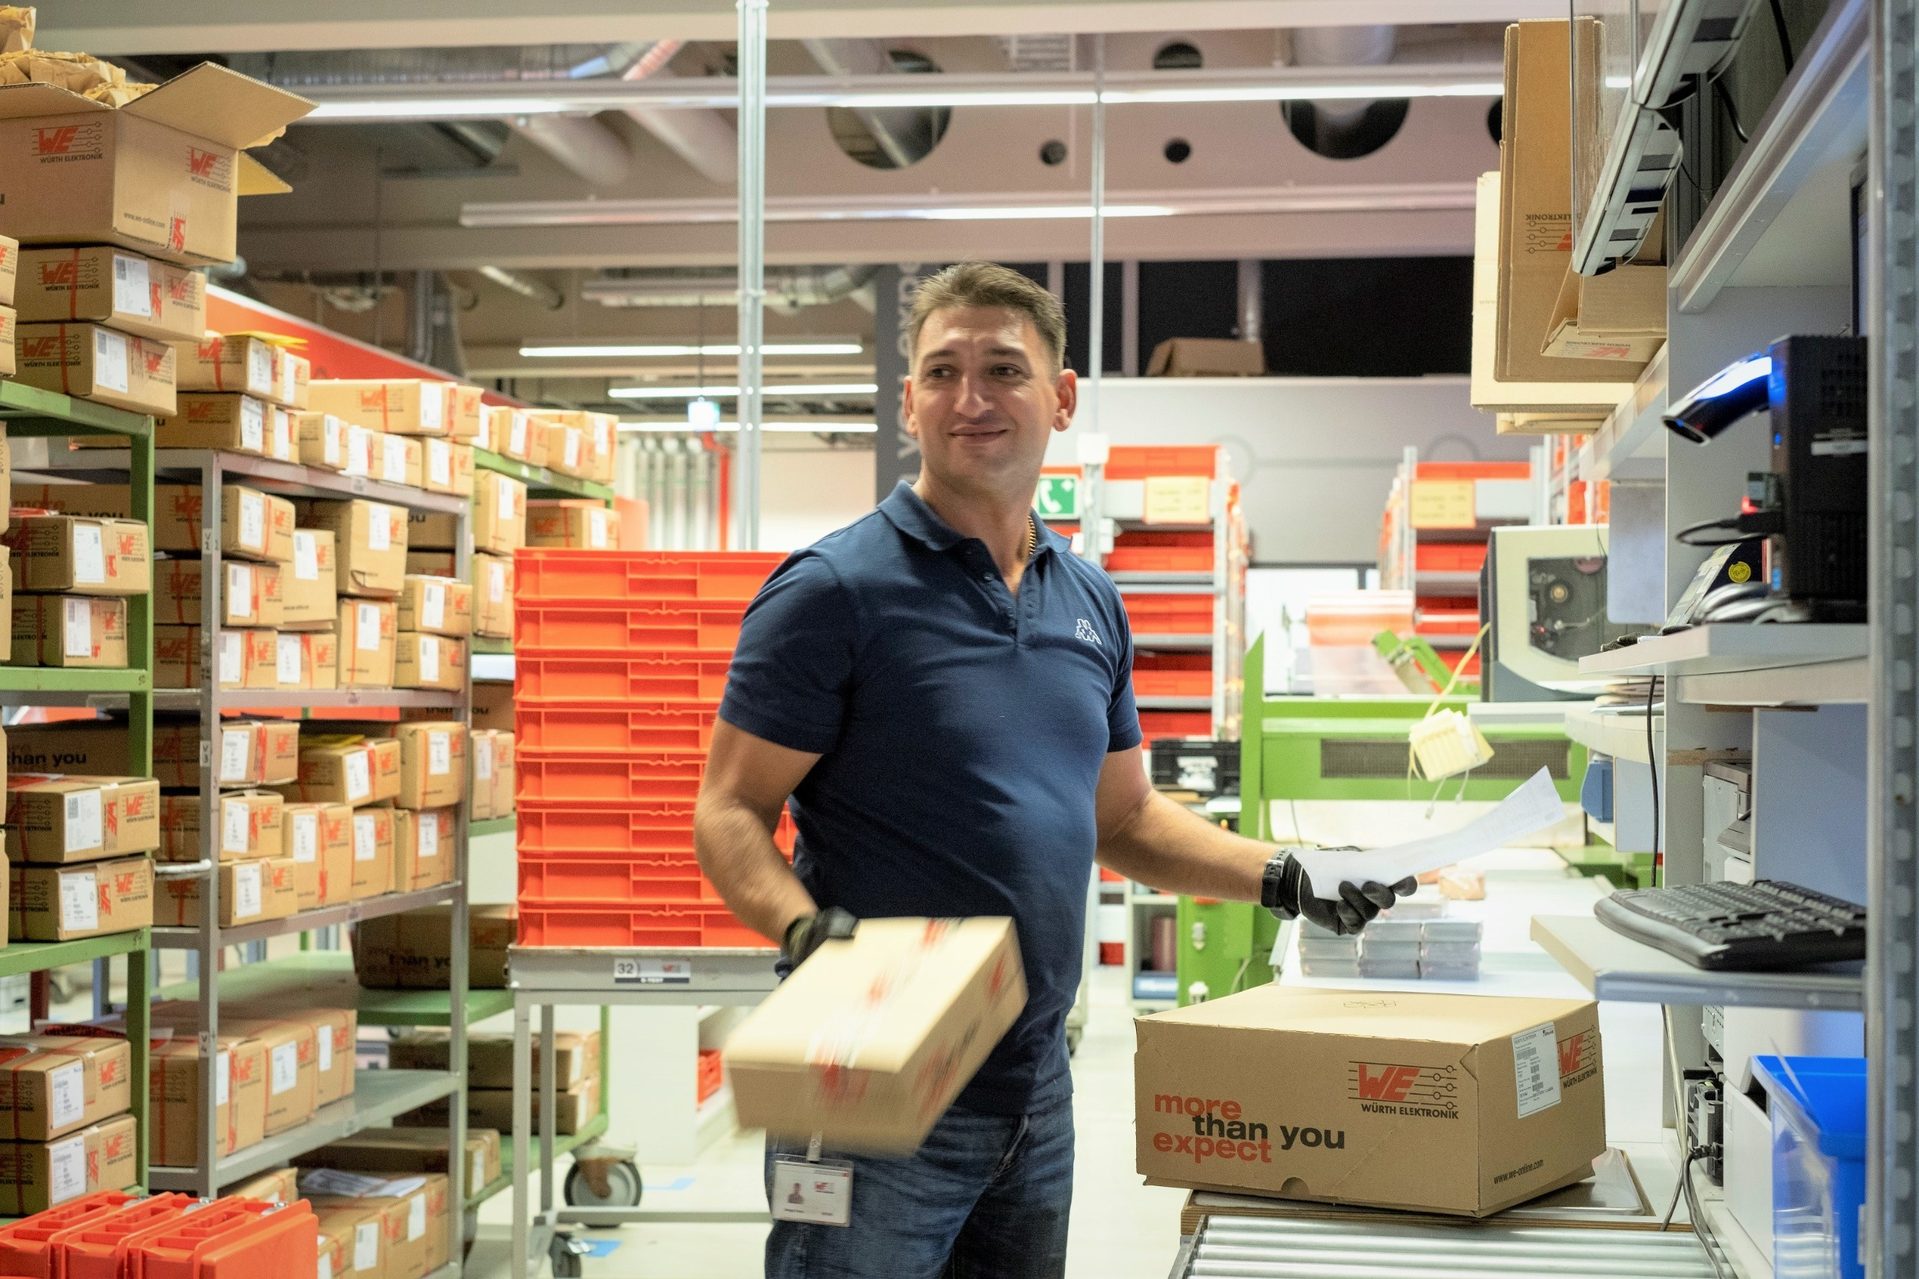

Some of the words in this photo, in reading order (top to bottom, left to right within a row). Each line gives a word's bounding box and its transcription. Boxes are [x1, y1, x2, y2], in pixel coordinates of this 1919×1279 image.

[38, 127, 80, 153] WE
[52, 753, 87, 768] you
[125, 795, 145, 816] WE
[115, 872, 135, 894] WE
[617, 963, 634, 974] 32
[1559, 1034, 1585, 1075] WE
[1357, 1062, 1421, 1102] WE
[1154, 1093, 1242, 1120] more
[1361, 1102, 1397, 1115] WÜRTH
[1399, 1105, 1459, 1120] ELEKTRONIK
[1192, 1112, 1269, 1141] than
[1279, 1124, 1346, 1151] you
[1152, 1131, 1273, 1164] expect
[1493, 1159, 1544, 1185] www.we-online.com
